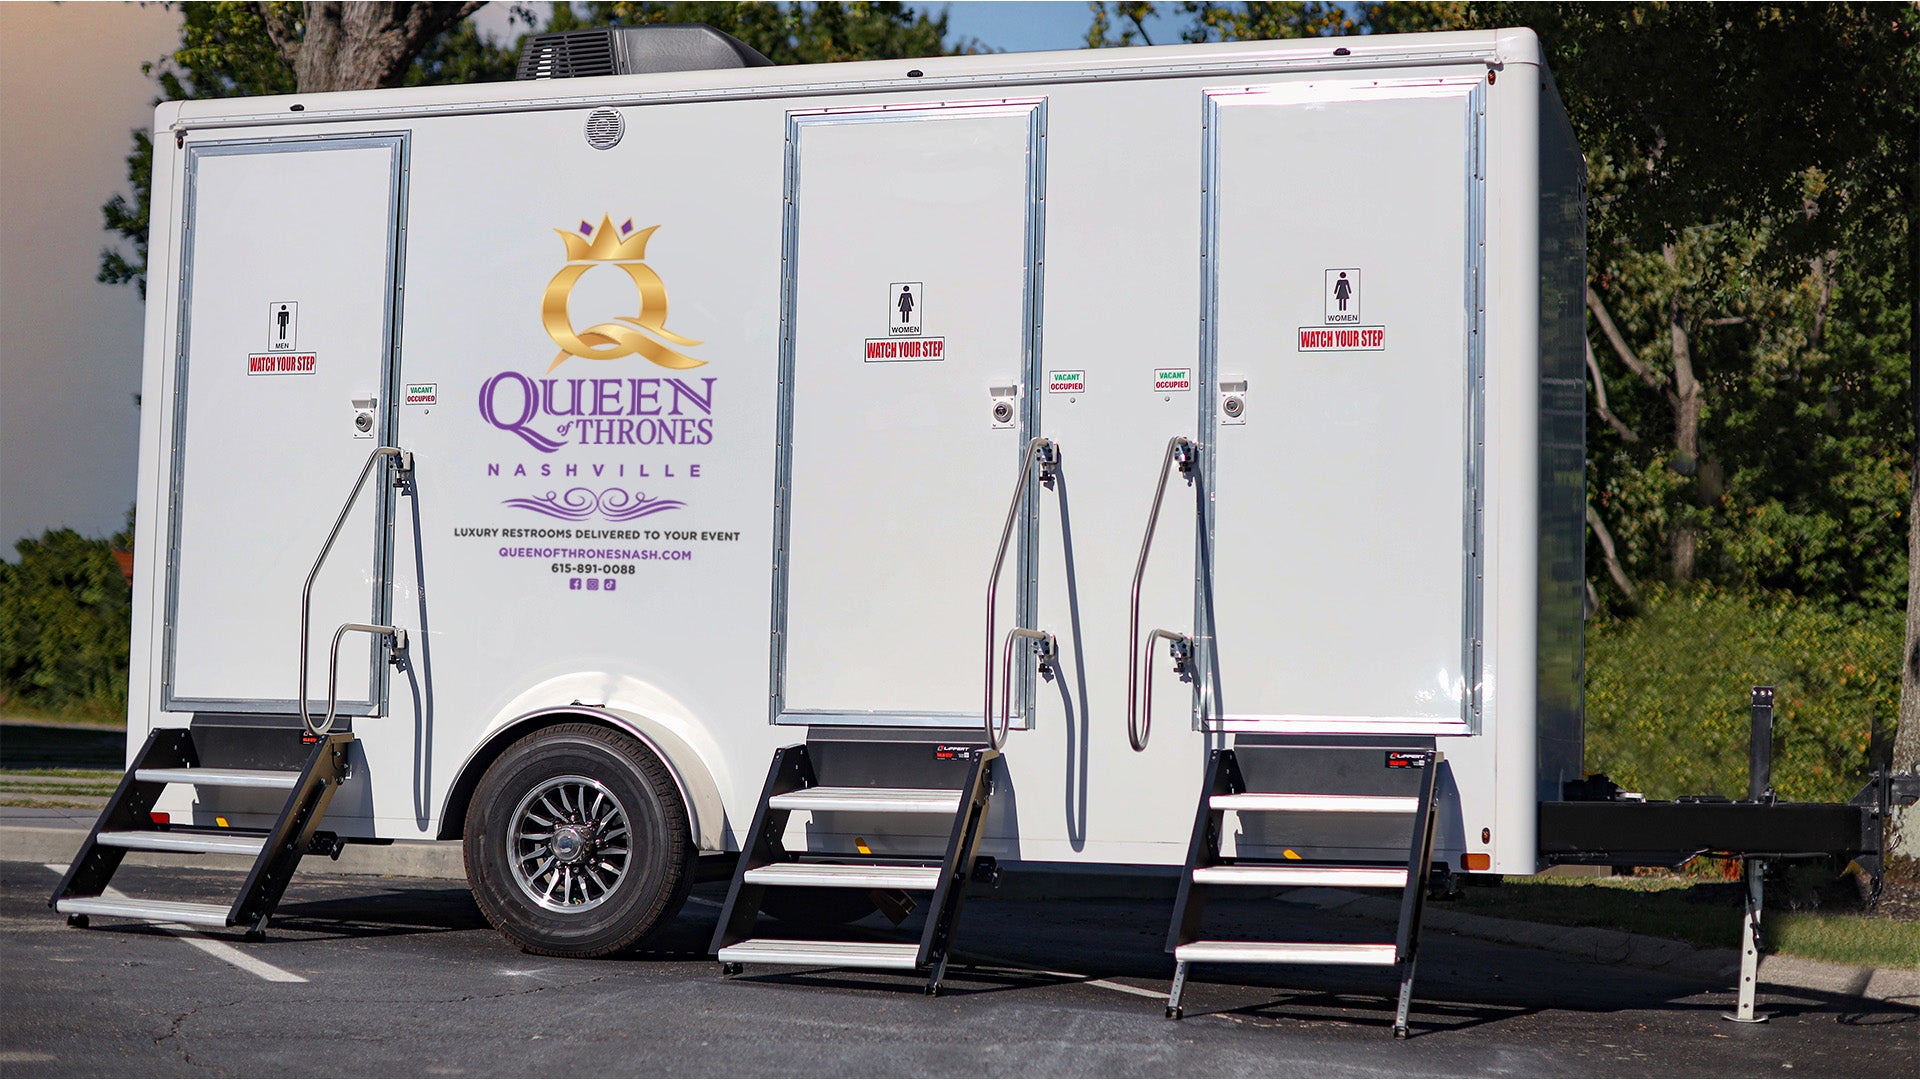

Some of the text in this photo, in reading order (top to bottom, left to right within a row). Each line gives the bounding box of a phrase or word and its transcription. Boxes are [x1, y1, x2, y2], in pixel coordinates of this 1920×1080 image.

[1327, 314, 1358, 322] WOMEN
[891, 326, 920, 334] WOMEN
[1300, 329, 1384, 348] WATCH YOUR STEP
[275, 342, 290, 350] MEN
[866, 340, 943, 359] WATCH YOUR STEP
[250, 355, 315, 372] WATCH YOUR STEP
[1054, 373, 1081, 381] VACANT
[1159, 371, 1186, 379] VACANT
[410, 386, 433, 394] VACANT
[1050, 382, 1084, 390] OCCUPIED
[1155, 380, 1189, 389] OCCUPIED
[478, 371, 718, 453] QUEEN
[556, 418, 714, 446] of THRONES
[487, 463, 701, 478] NASHVILLE
[454, 527, 741, 542] LUXURY RESTROOMS DELIVERED TO YOUR EVENT
[499, 547, 692, 561] QUEENOFTHRONESNASH.COM
[551, 563, 636, 575] 615-891-0088
